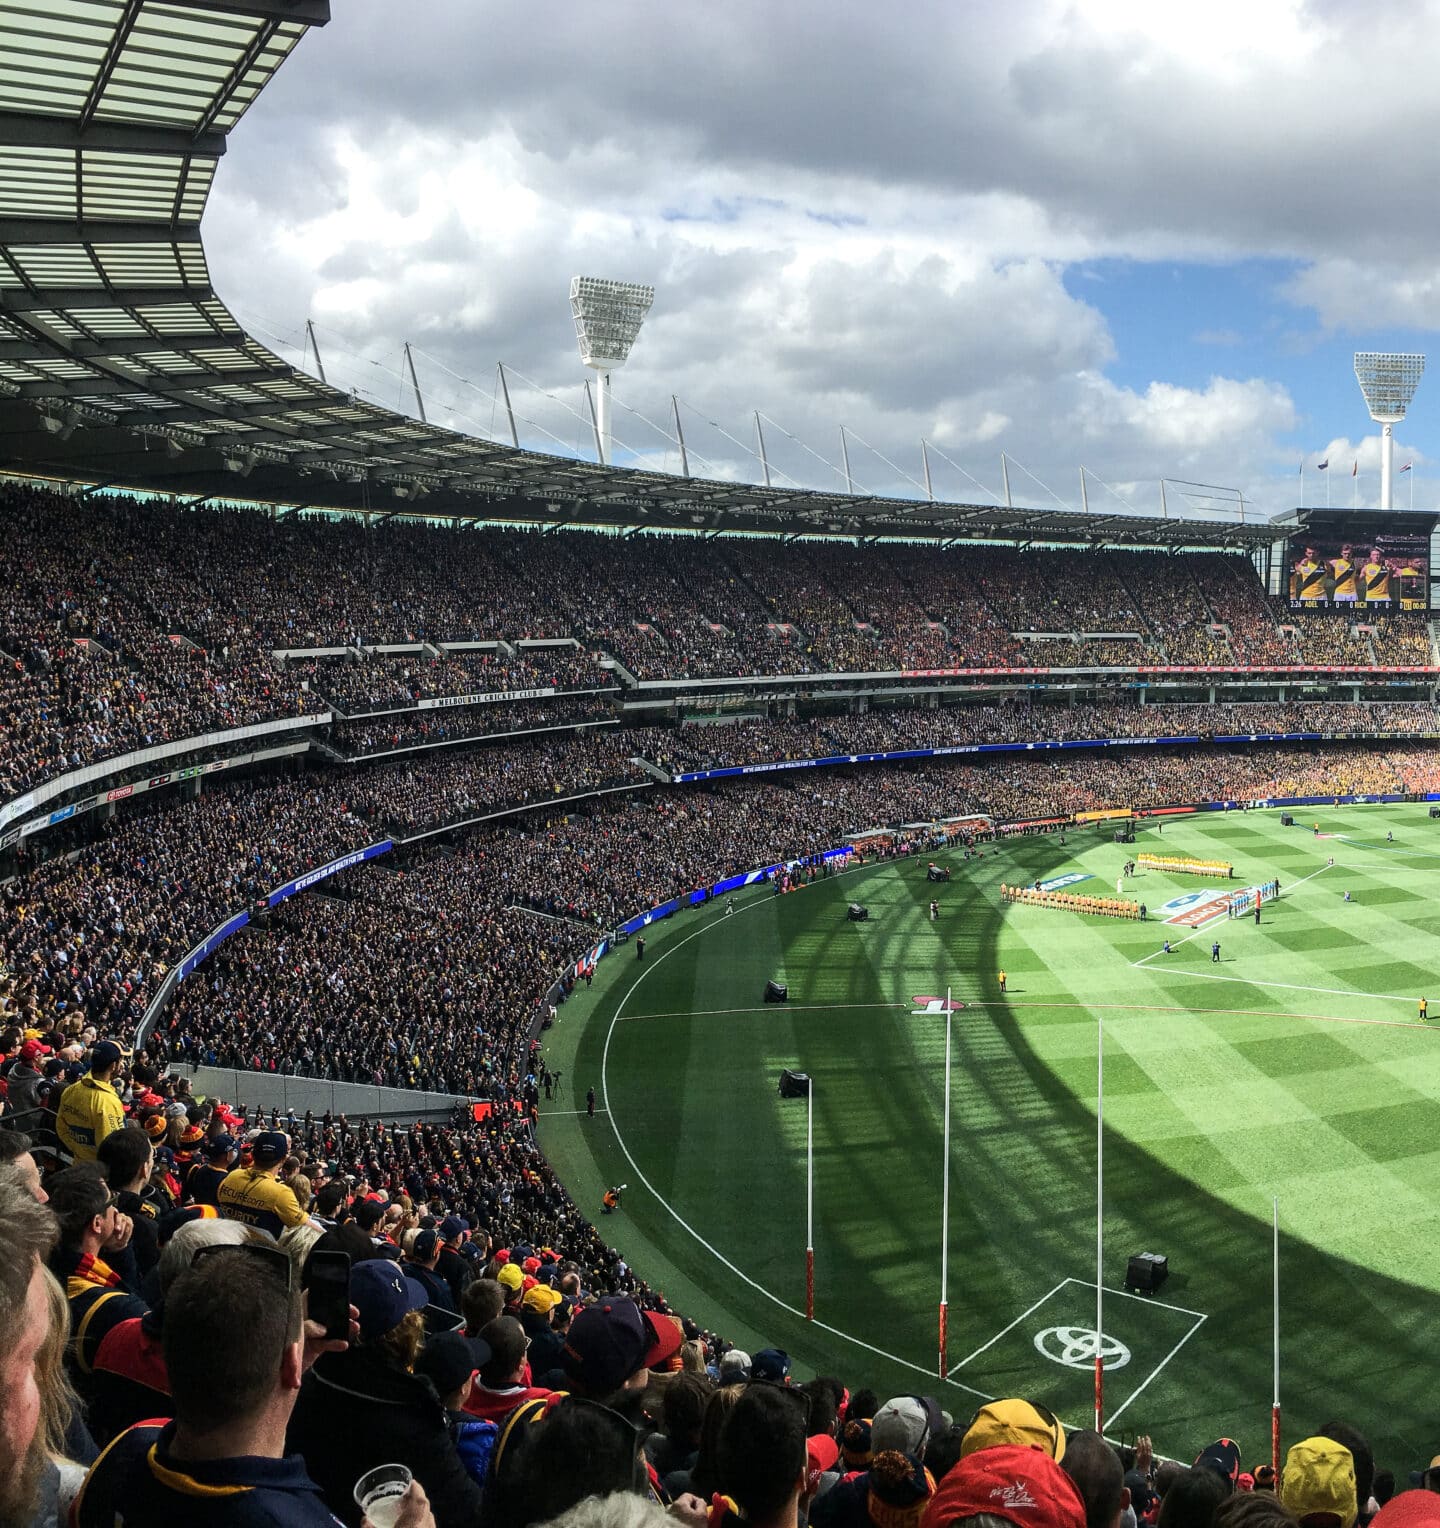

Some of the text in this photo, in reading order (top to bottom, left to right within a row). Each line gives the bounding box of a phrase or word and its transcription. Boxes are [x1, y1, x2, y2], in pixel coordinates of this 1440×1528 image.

[484, 692, 517, 702] CRICKET
[519, 689, 538, 698] CLUB
[307, 874, 320, 885] GOLDEN
[320, 868, 328, 878] SOIL
[328, 865, 336, 874] AND
[335, 860, 348, 870] WEALTH
[348, 856, 357, 864] FOR
